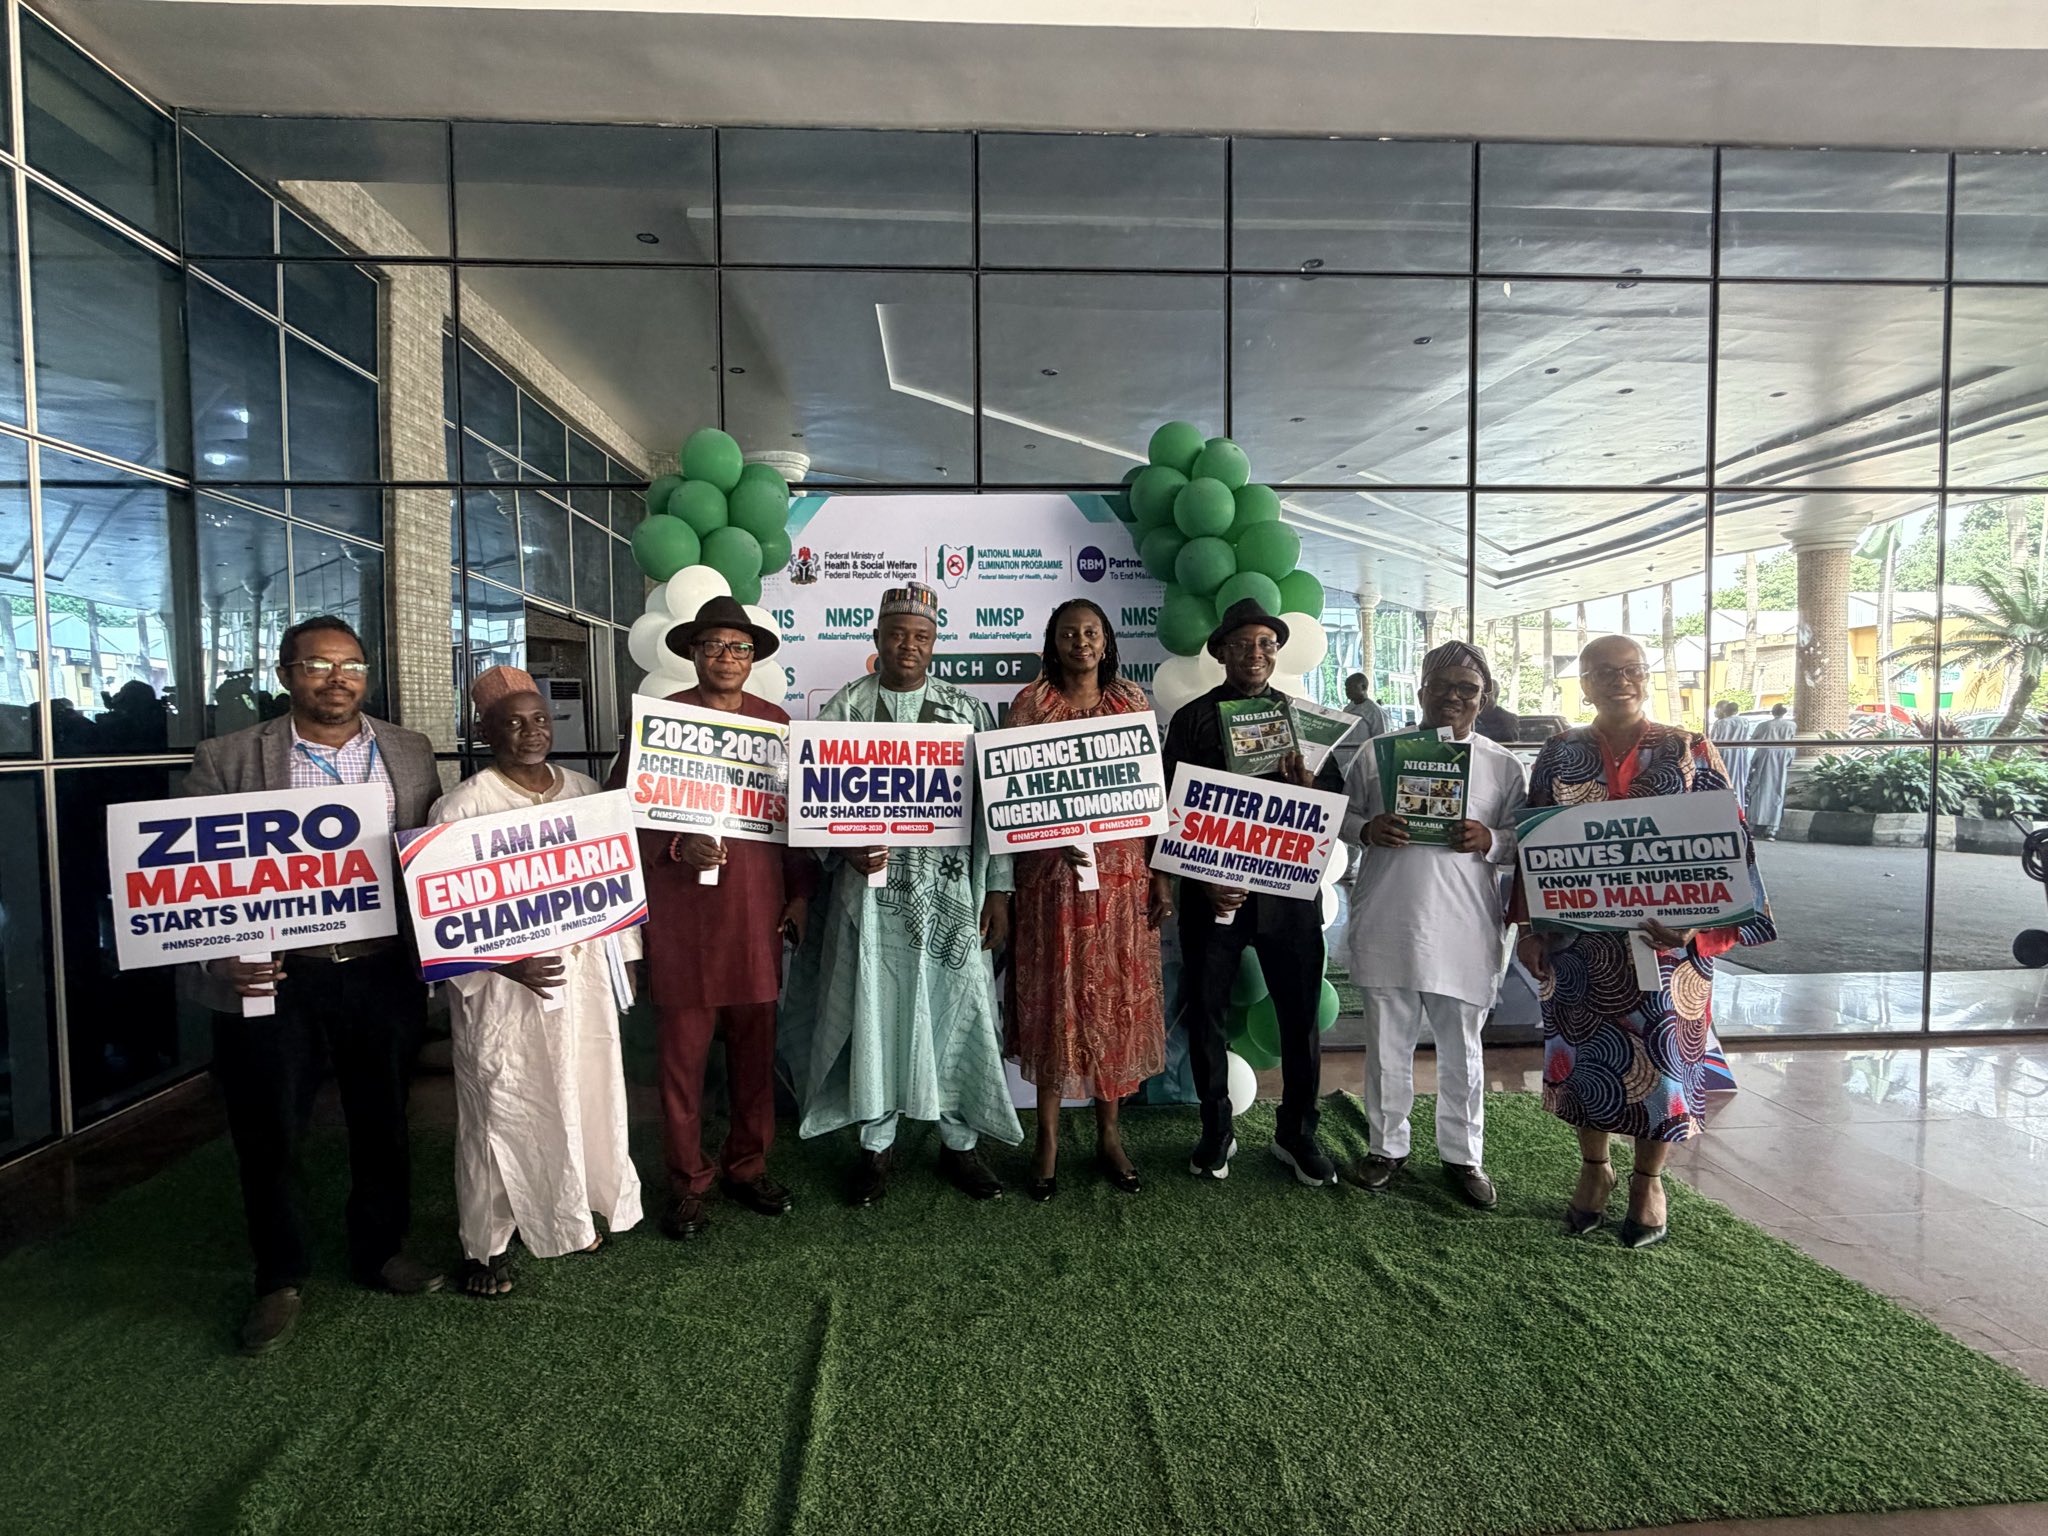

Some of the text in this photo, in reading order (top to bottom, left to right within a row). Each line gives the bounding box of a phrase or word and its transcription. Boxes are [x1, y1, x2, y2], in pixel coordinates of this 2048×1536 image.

[824, 552, 885, 562] Federal Ministry of
[824, 561, 917, 570] Health & Social Welfare
[977, 549, 1042, 558] NATIONAL MALARIA
[978, 560, 1063, 569] ELIMINATION PROGRAMME
[1079, 558, 1104, 570] RBM
[1109, 557, 1142, 568] Partne
[824, 571, 917, 581] Federal Republic of Nigeria
[998, 573, 1018, 581] Ministry
[1109, 571, 1119, 580] To
[1120, 571, 1134, 580] End
[826, 607, 874, 627] NMSP
[976, 607, 1024, 627] NMSP
[1121, 606, 1161, 626] NMS
[969, 631, 1032, 641] #MalariaFreeNigeria
[995, 660, 1022, 676] OF
[1231, 709, 1283, 723] NIGERIA
[647, 718, 782, 769] 2026-2030
[799, 739, 964, 766] A MALARIA FREE
[989, 739, 1081, 776] EVIDENCE
[1082, 729, 1150, 762] TODAY:
[1249, 753, 1281, 763] MALARIA
[1403, 760, 1461, 773] NIGERIA
[637, 753, 744, 788] ACCELERATING
[1006, 761, 1142, 799] A HEALTHIER
[634, 772, 726, 813] SAVING
[803, 766, 963, 804] NIGERIA:
[651, 811, 713, 825] #NMSP2026-2030
[799, 805, 963, 818] OUR SHARED DESTINATION
[991, 787, 1161, 828] NIGERIA TOMORROW
[1184, 779, 1329, 834] BETTER DATA:
[138, 803, 361, 868] ZERO
[832, 825, 883, 833] #NMSP2026-2030
[1012, 818, 1144, 842] #NMSP2026-2030 #NMIS2025
[1408, 820, 1444, 829] MALARIA
[1583, 816, 1661, 841] DATA
[471, 815, 578, 861] I AM AN
[1180, 811, 1315, 865] SMARTER
[1160, 838, 1320, 885] MALARIA INTERVENTIONS
[1528, 835, 1735, 870] DRIVES ACTION
[125, 849, 379, 908] MALARIA
[424, 838, 630, 913] END MALARIA
[1180, 862, 1292, 891] #NMSP2026-2030 #NMIS2025
[1537, 866, 1734, 890] KNOW THE NUMBERS,
[1542, 881, 1733, 910] END MALARIA
[130, 884, 381, 936] STARTS WITH ME
[434, 874, 634, 950] CHAMPION
[1558, 906, 1720, 919] #NMSP2026-2030 #NMIS2025
[162, 920, 347, 951] #NMSP2026-2030 #NMIS2025
[473, 912, 607, 955] #NMSP2026-2030 #NMIS2025
